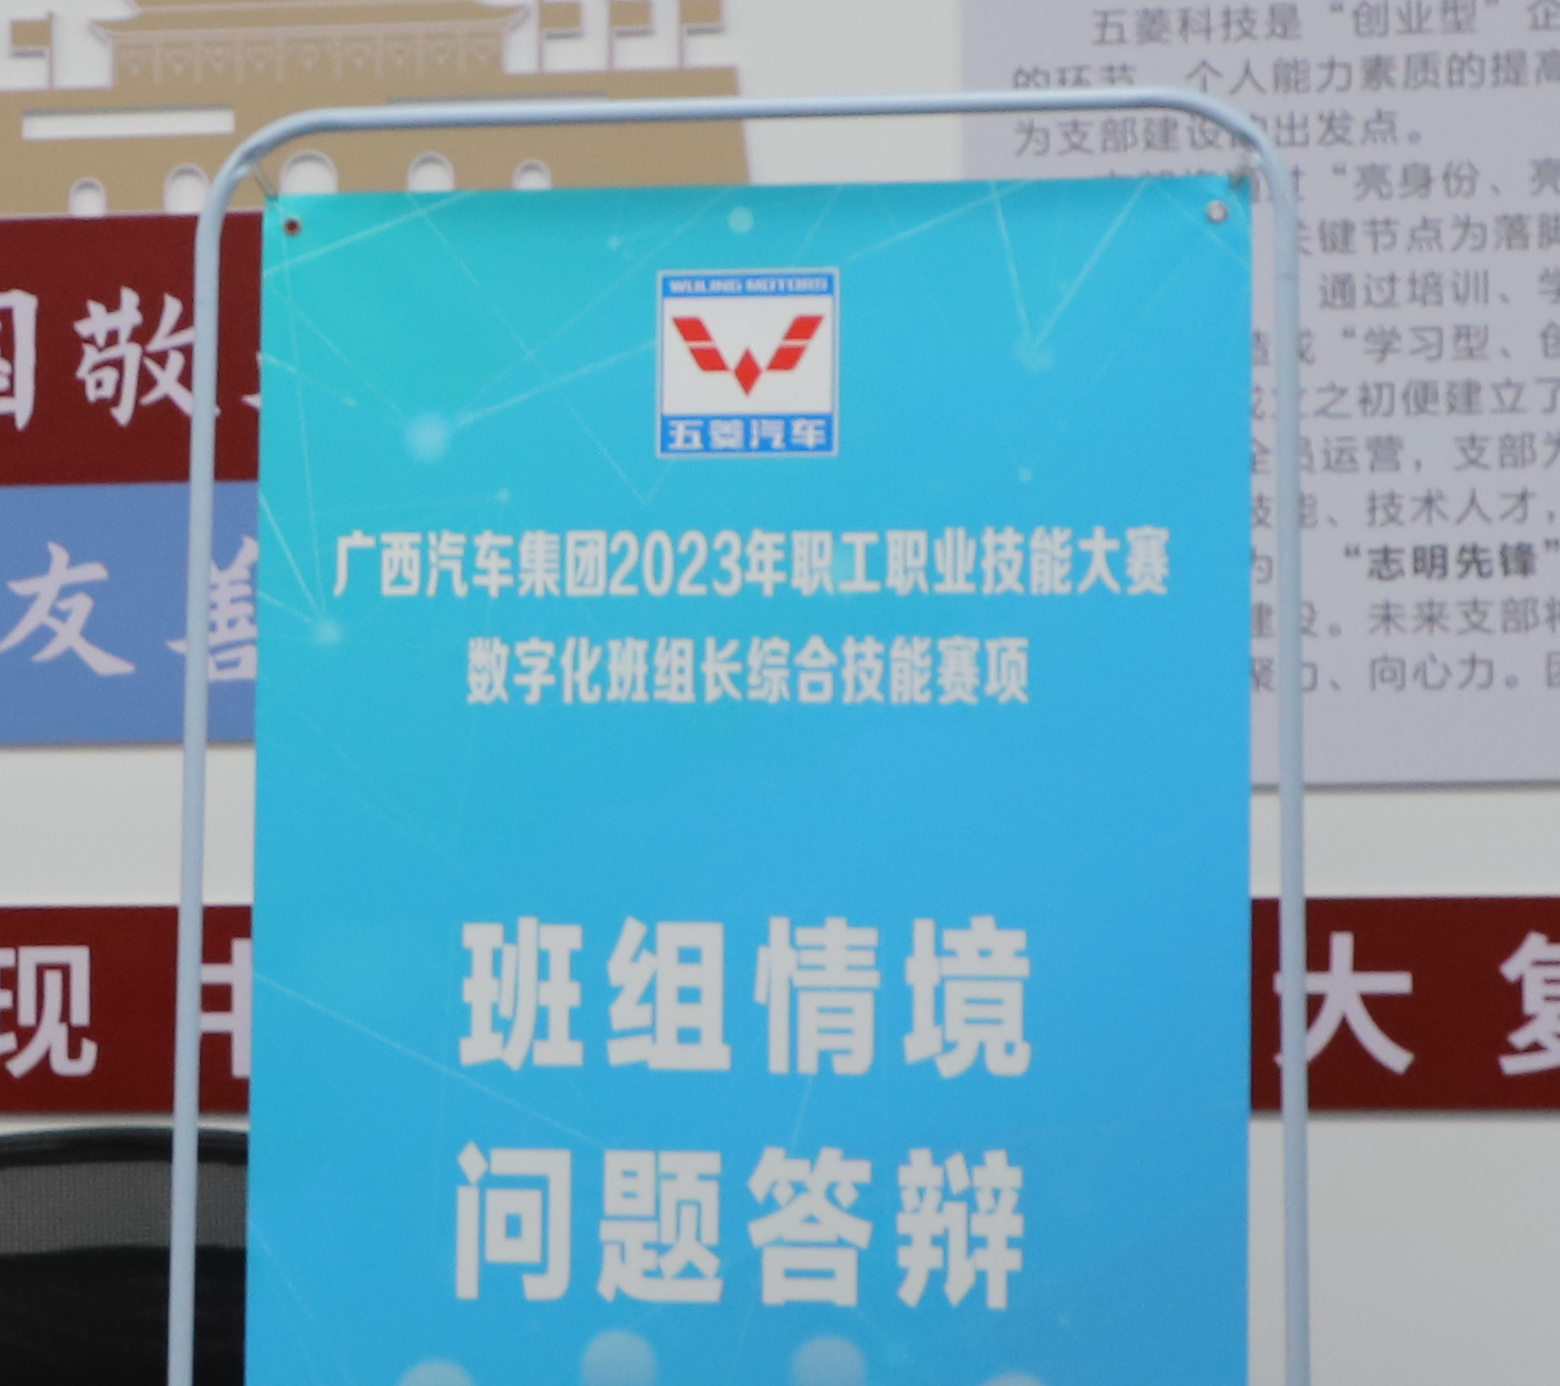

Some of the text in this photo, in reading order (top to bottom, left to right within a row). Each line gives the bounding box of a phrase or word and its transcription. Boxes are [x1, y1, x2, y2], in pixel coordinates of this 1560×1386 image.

[667, 417, 828, 451] 五菱汽车
[332, 523, 1172, 602] 广西汽车集团2023年职工职业技能大赛
[464, 633, 1031, 709] 数字化班组长综合技能赛项
[458, 913, 1034, 1080] 班组情境
[452, 1142, 1027, 1312] 问题答辩
